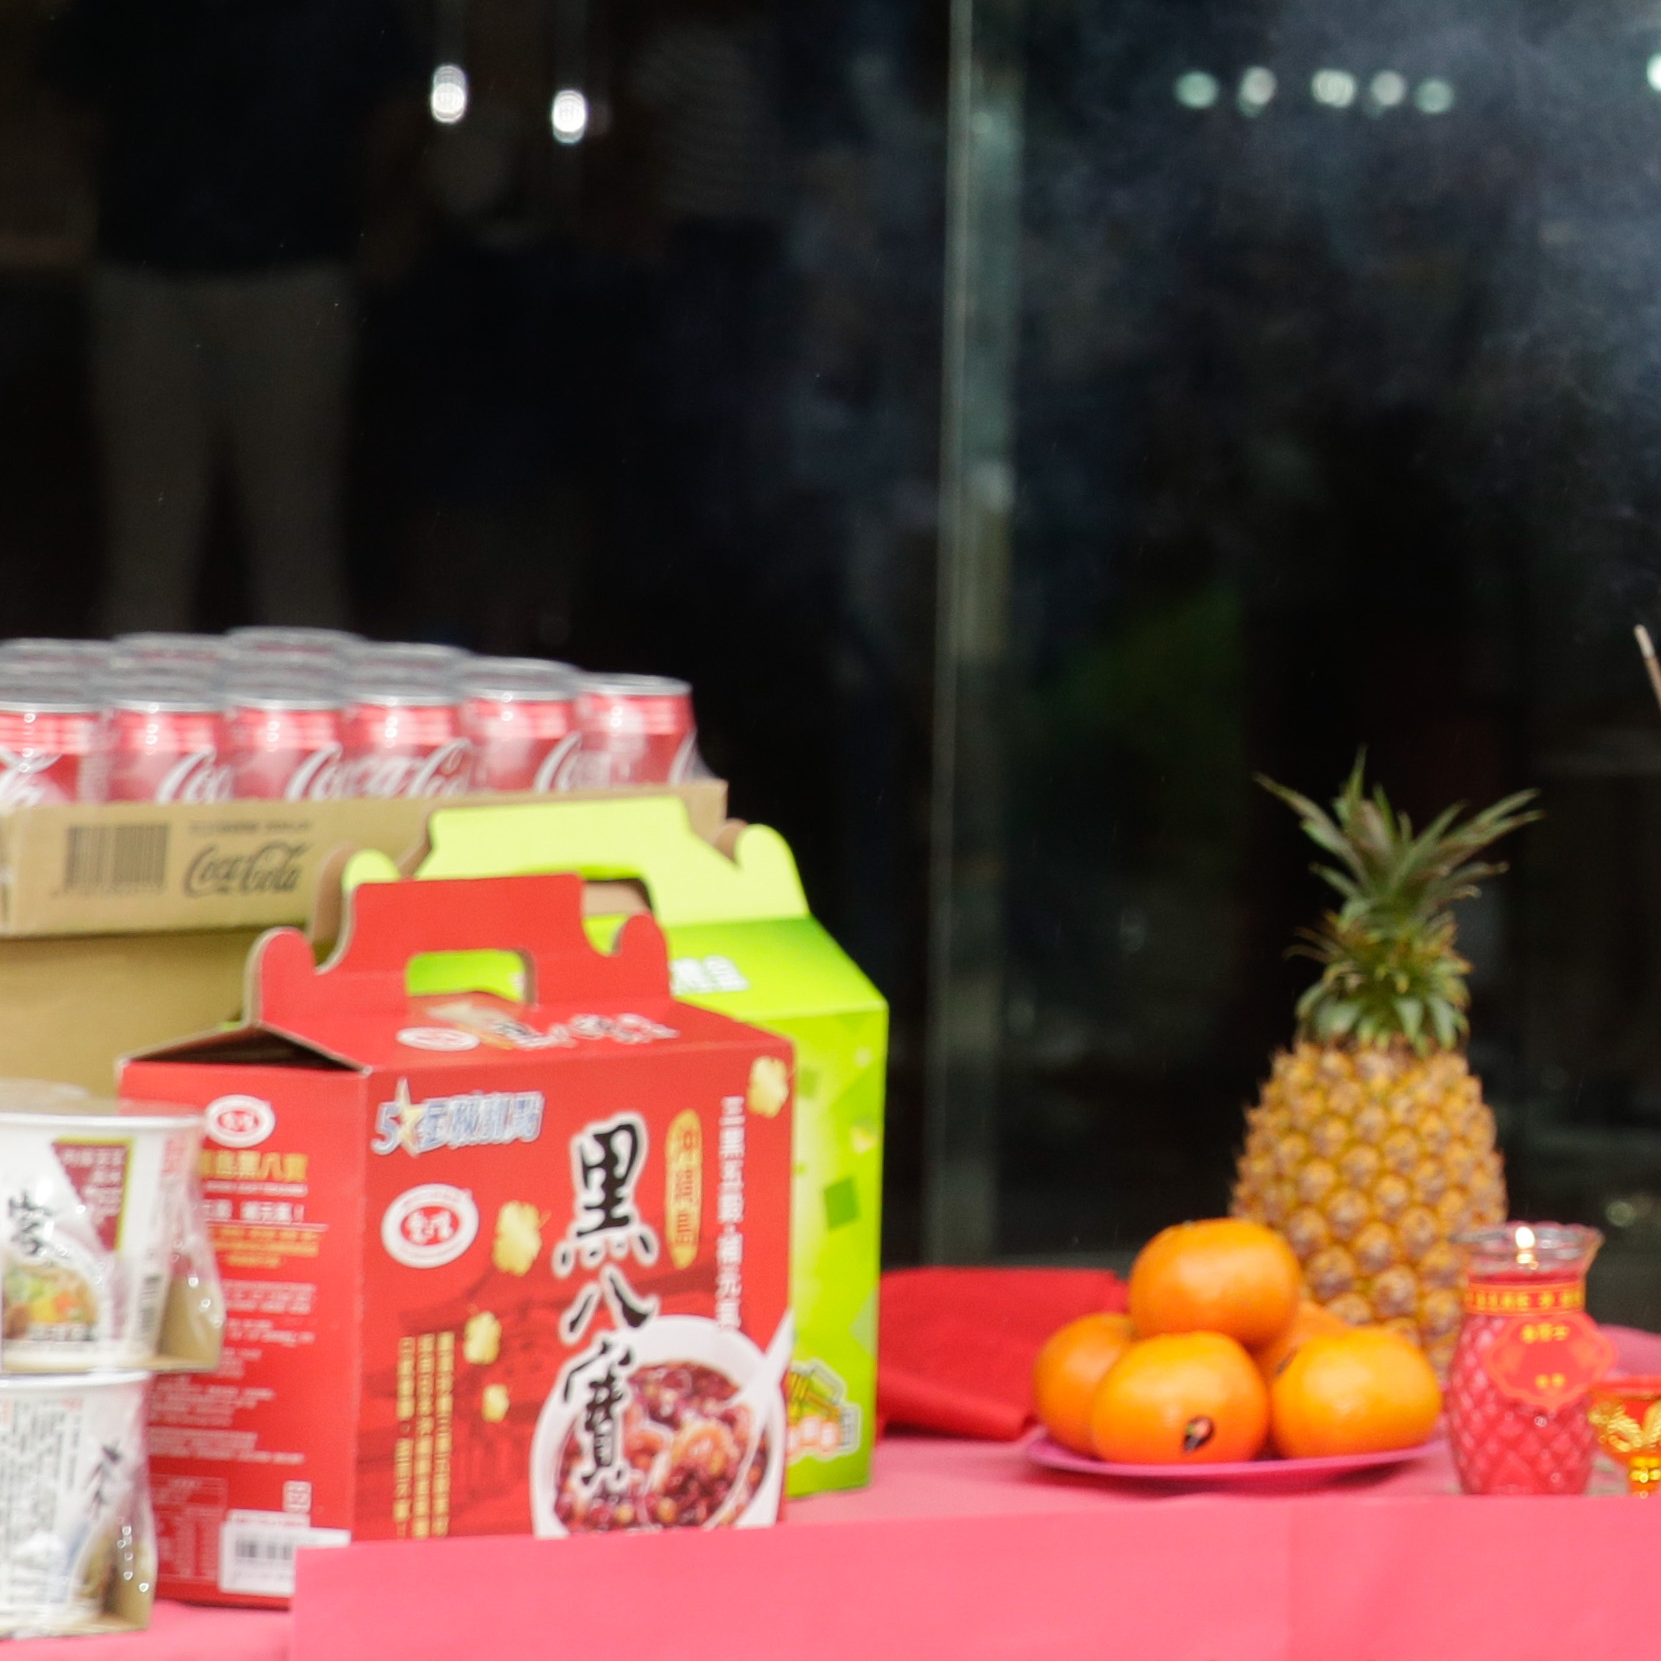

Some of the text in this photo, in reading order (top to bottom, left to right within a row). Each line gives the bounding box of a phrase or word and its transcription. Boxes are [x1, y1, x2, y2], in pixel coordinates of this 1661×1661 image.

[183, 840, 311, 899] Coca-Cola
[558, 1121, 657, 1487] 黑八寶
